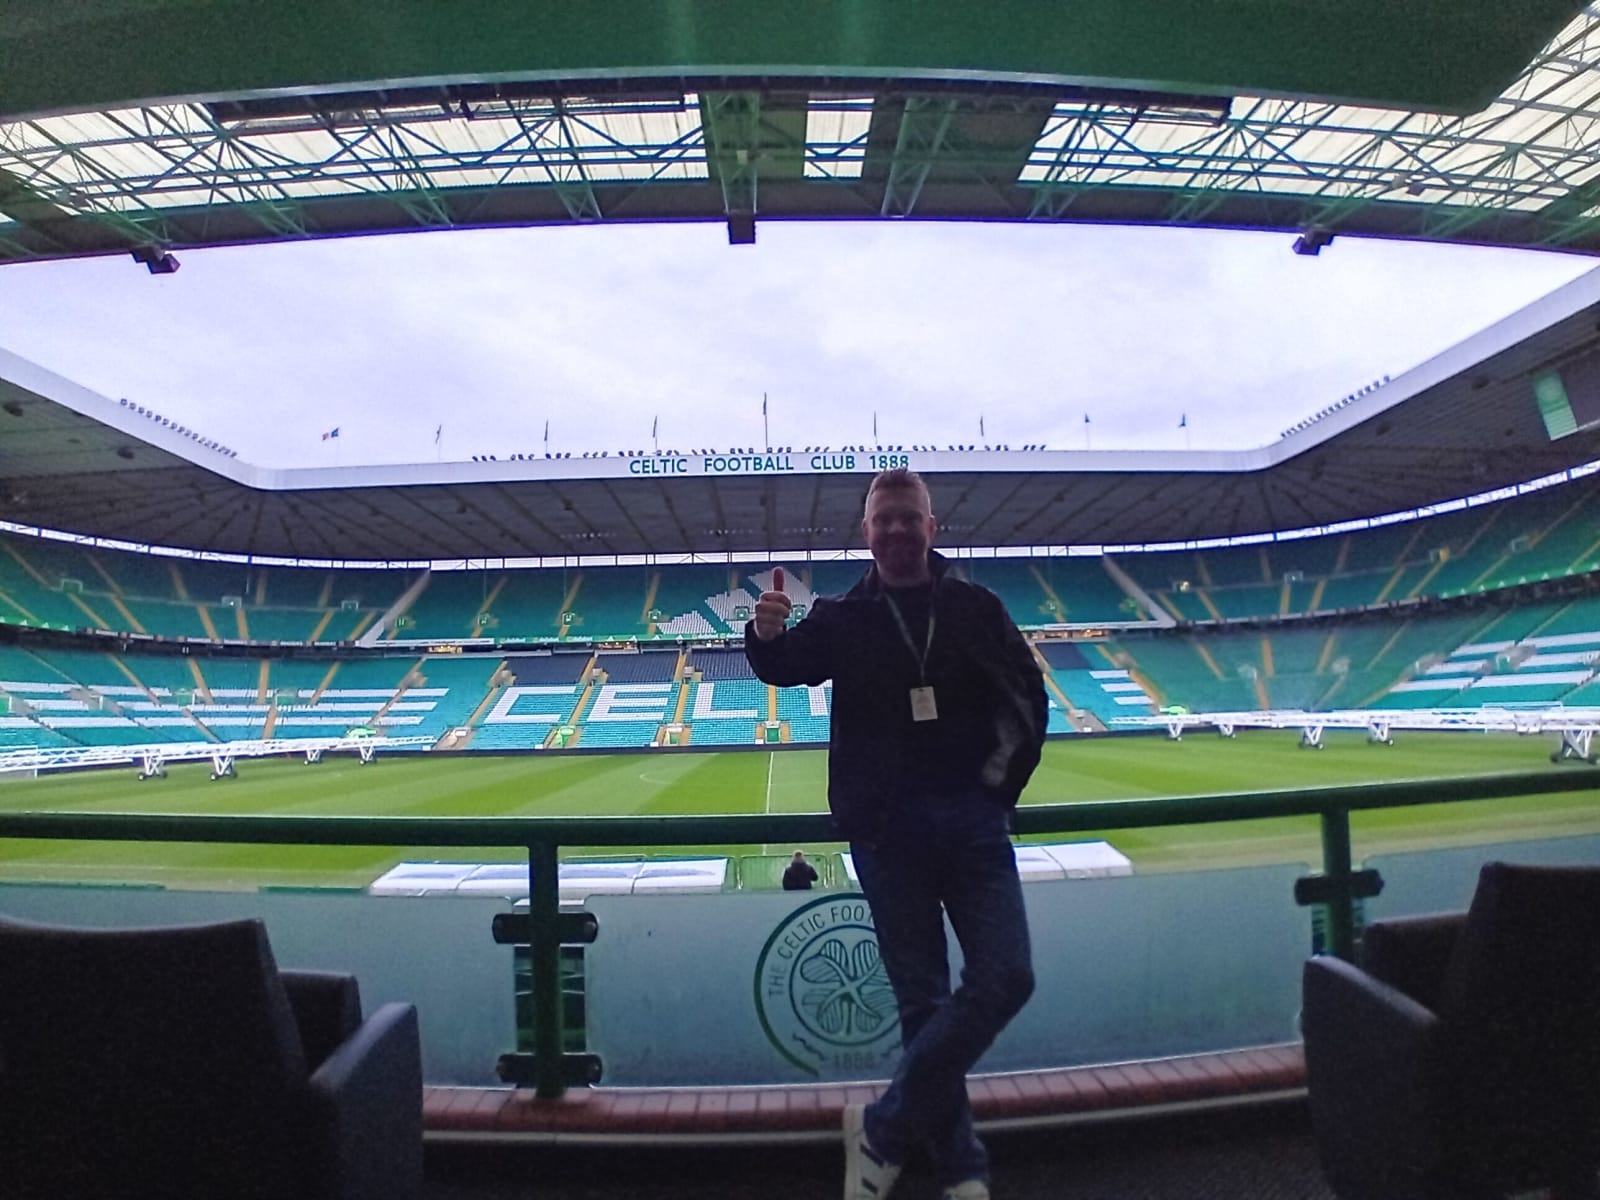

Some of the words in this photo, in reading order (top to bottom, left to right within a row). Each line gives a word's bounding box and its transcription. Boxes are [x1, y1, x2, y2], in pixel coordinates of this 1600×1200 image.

[629, 459, 688, 474] CELTIC
[703, 456, 794, 473] FOOTBALL
[810, 455, 856, 470] CLUB
[869, 455, 909, 470] 1888
[768, 966, 786, 998] THE
[777, 912, 827, 961] CELTIC
[830, 904, 872, 924] FOO
